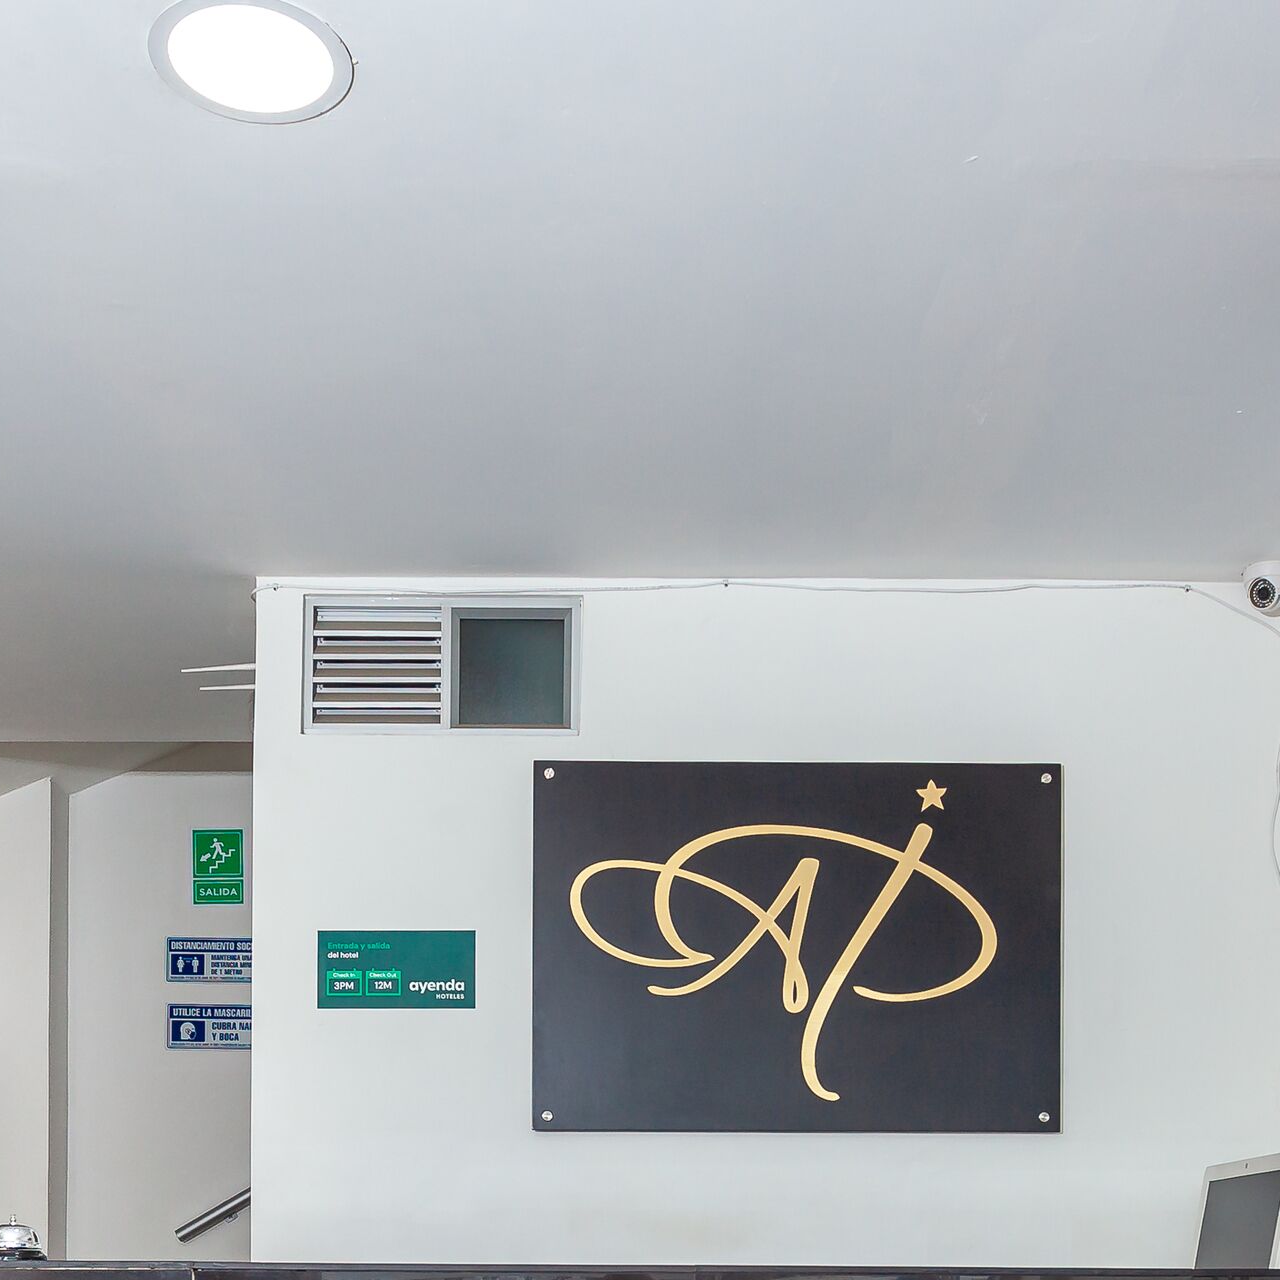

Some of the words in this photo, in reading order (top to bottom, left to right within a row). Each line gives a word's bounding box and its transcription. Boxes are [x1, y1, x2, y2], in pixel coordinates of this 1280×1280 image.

[200, 888, 238, 896] SALIDA
[170, 941, 234, 950] DISTANCIAMIENTO
[327, 942, 358, 950] Entrada
[367, 942, 391, 950] salida
[334, 981, 354, 990] 3PM
[374, 981, 392, 990] 12M
[409, 978, 465, 994] ayenda
[172, 1008, 201, 1017] UTILICE
[202, 1008, 212, 1017] LA
[212, 1022, 238, 1030] CUBRA
[212, 1033, 217, 1041] Y
[219, 1033, 239, 1041] BOCA
